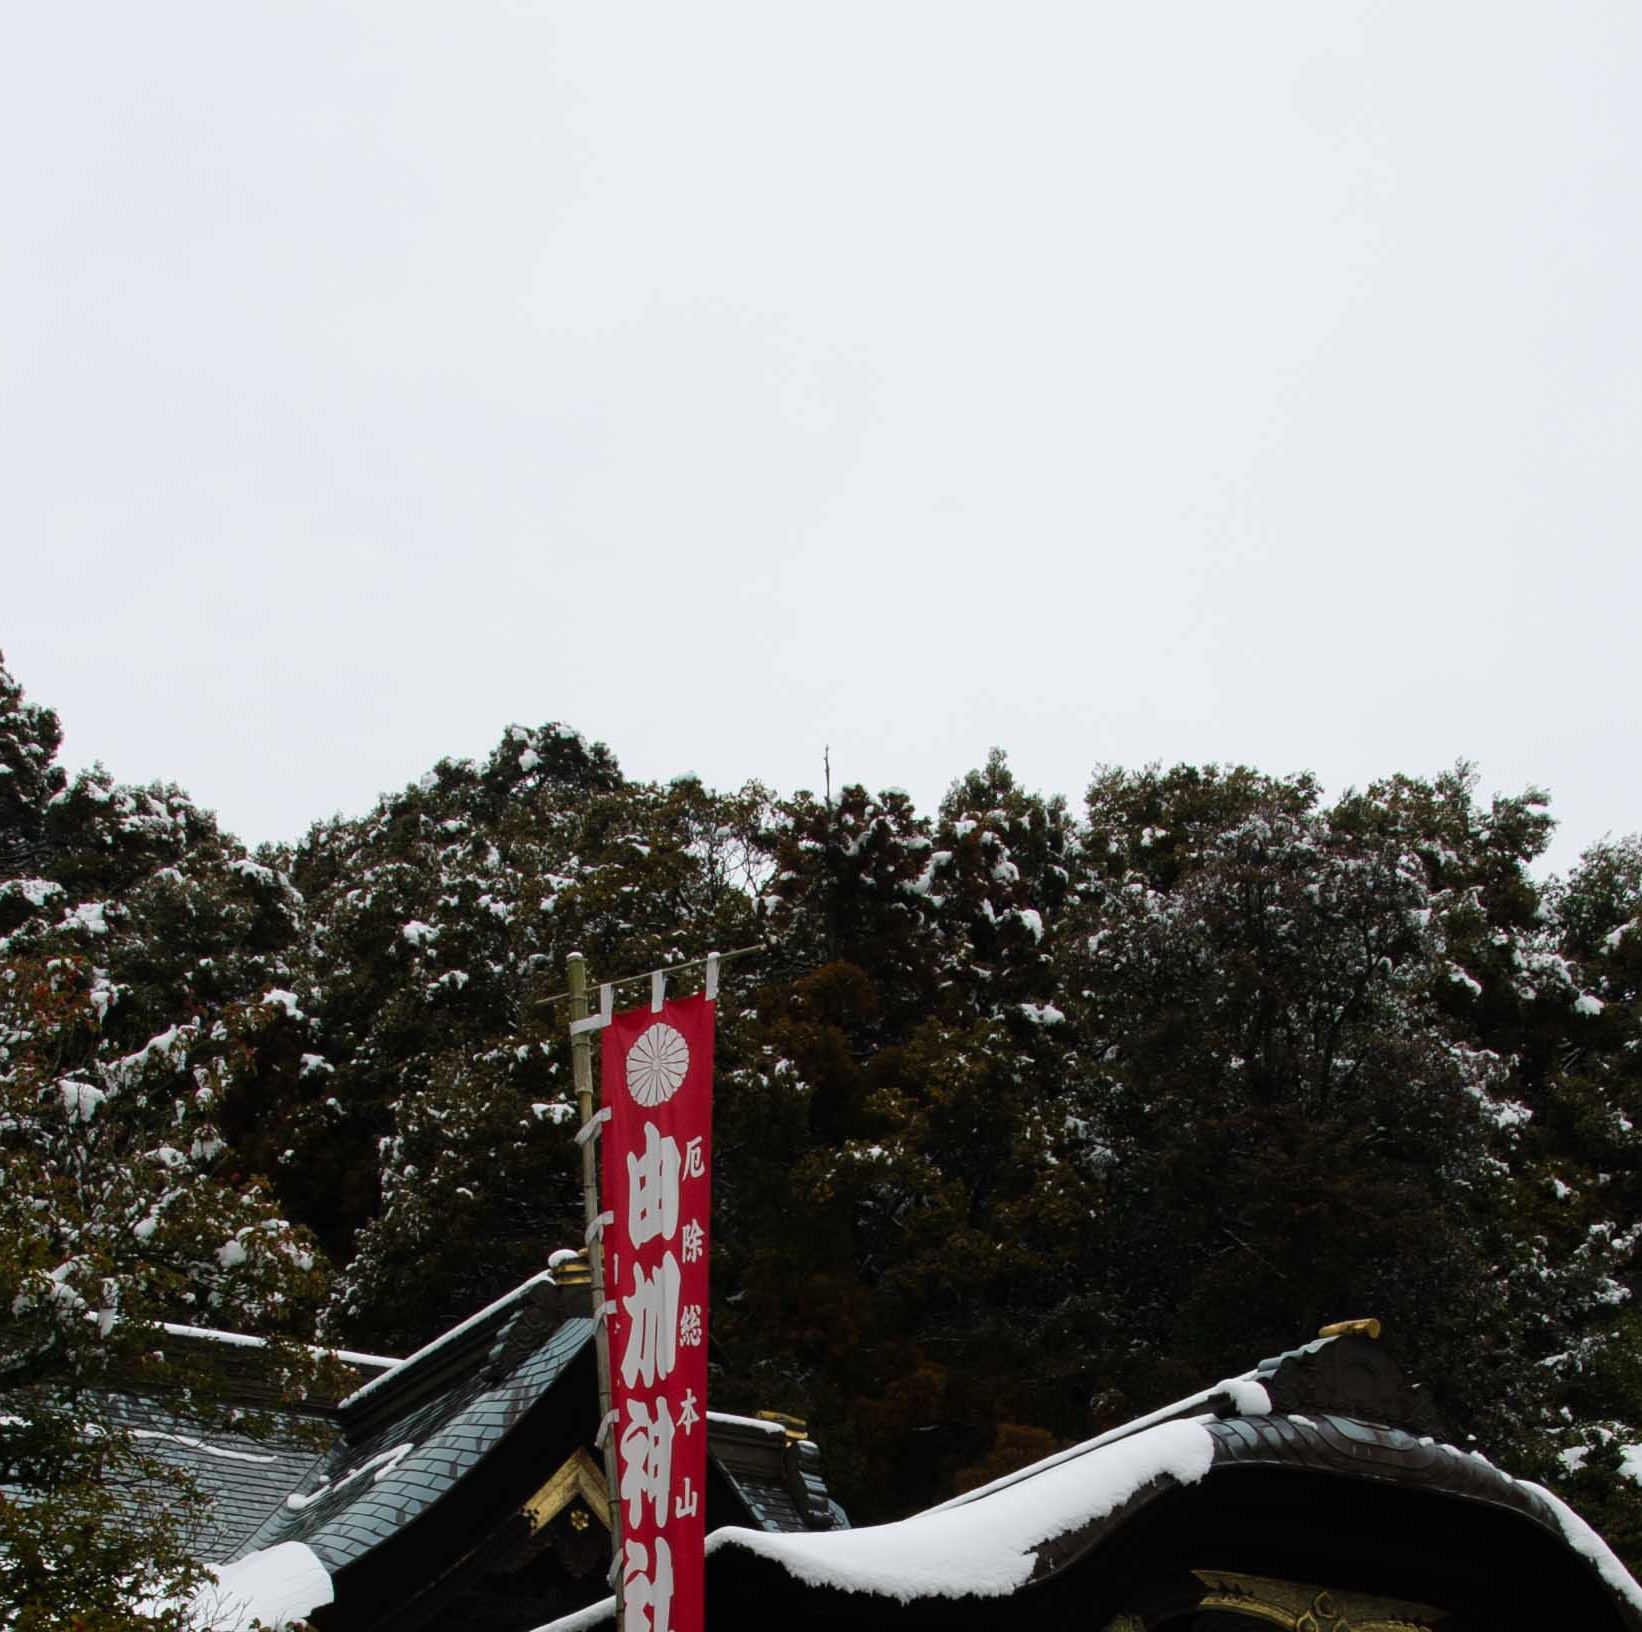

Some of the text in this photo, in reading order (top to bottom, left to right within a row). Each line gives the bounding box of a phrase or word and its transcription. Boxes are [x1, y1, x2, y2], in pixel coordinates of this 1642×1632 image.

[677, 1136, 705, 1520] 厄除総本山
